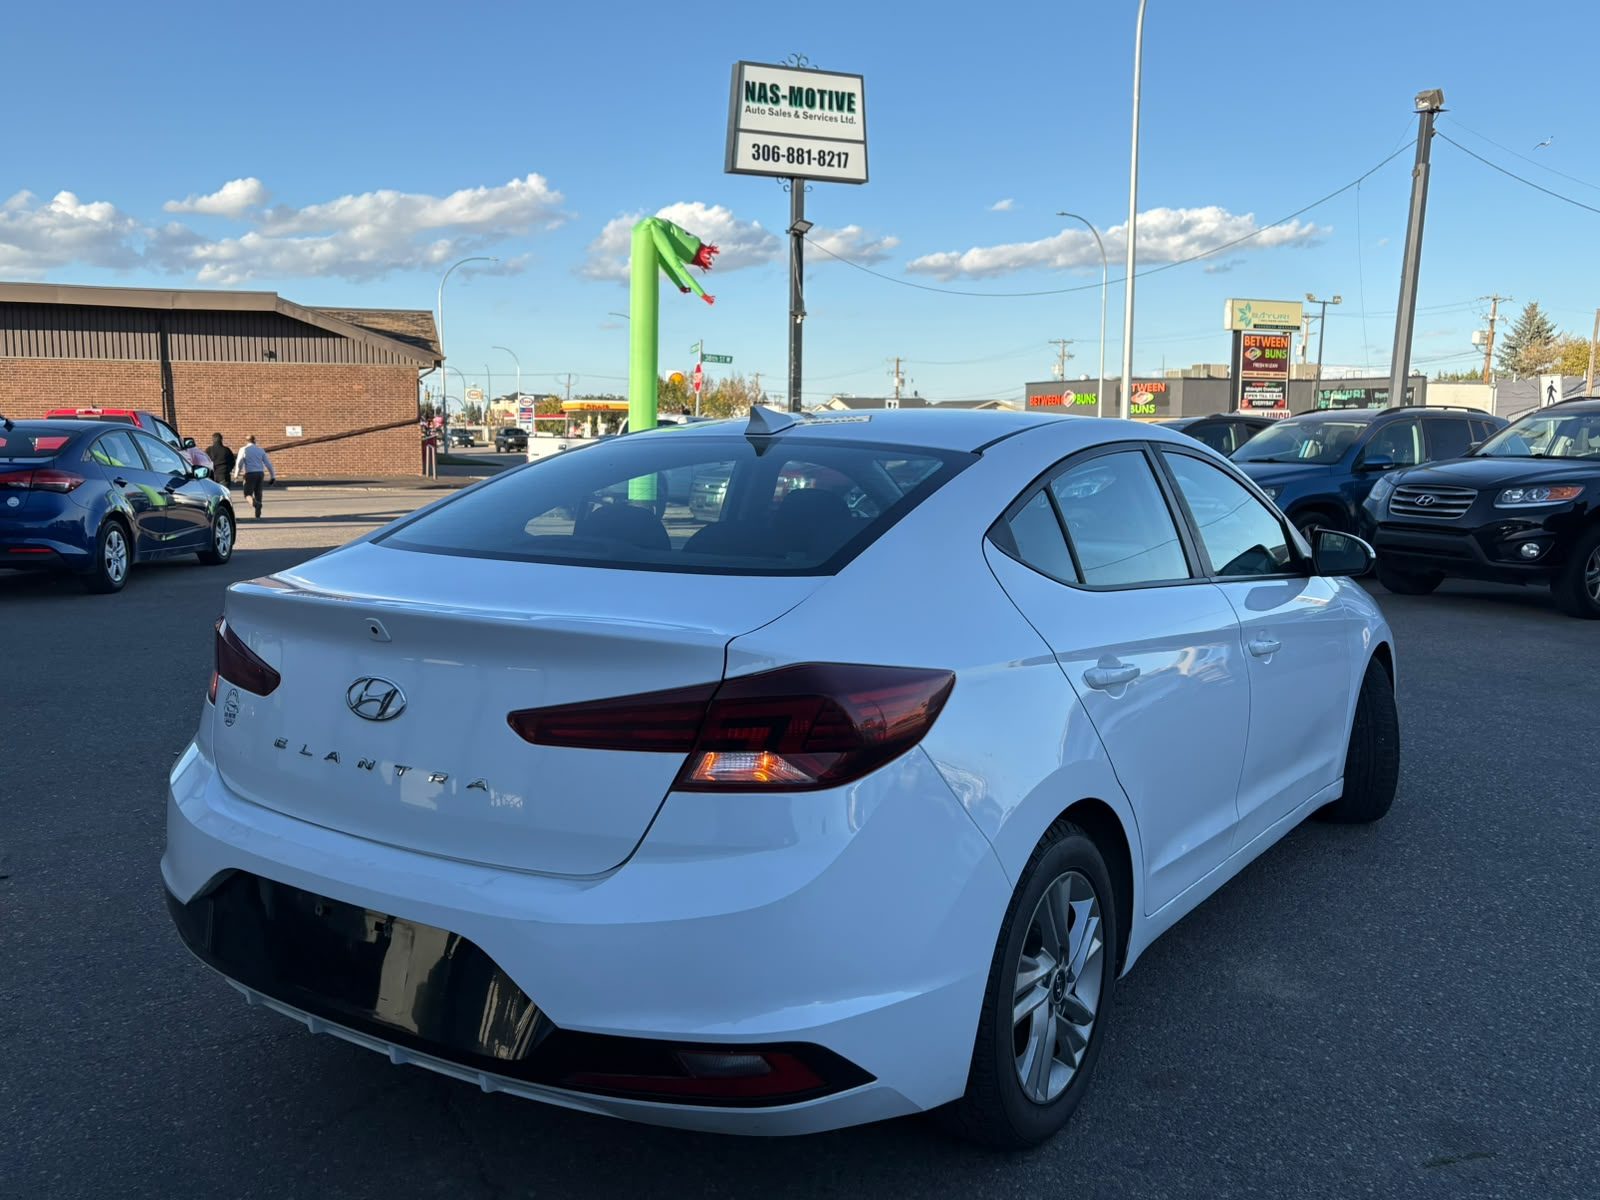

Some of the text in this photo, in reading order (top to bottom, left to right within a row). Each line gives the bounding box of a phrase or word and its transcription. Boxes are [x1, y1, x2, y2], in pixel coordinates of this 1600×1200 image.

[745, 81, 856, 114] NAS-MOTIVE
[745, 105, 856, 125] Auto Sales & Services Ltd.
[752, 143, 849, 169] 306-881-8217
[1244, 336, 1287, 348] BETWEEN
[1265, 348, 1287, 359] BUNS
[1030, 393, 1096, 406] BETWEEN BUNS
[1130, 404, 1155, 414] BUNS
[273, 736, 489, 792] ELANTRA
